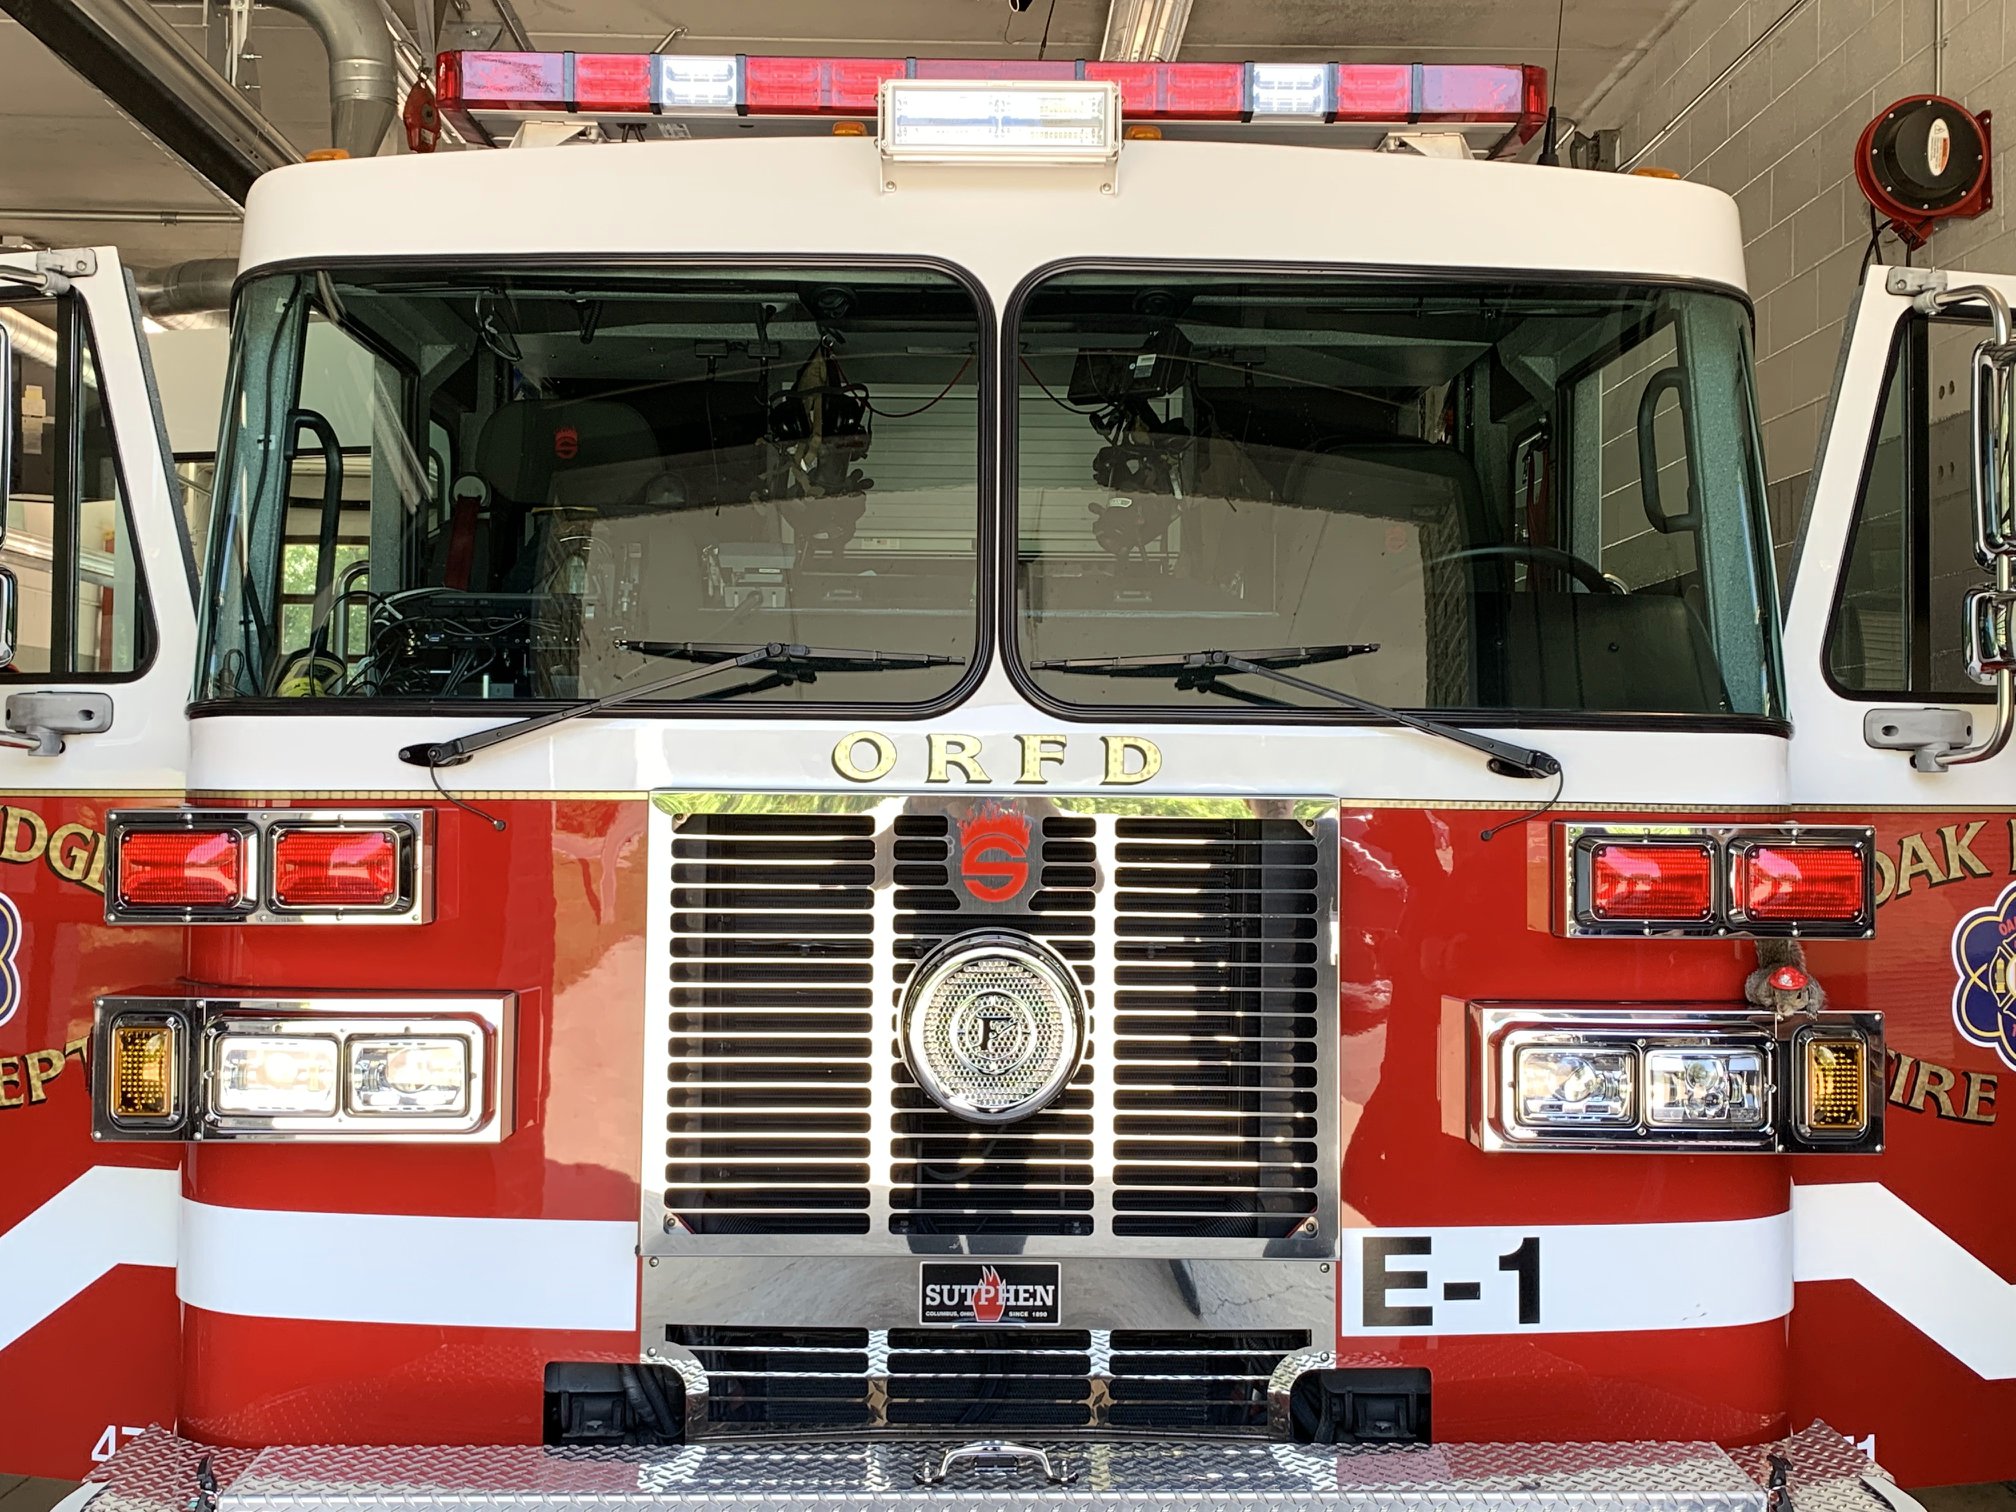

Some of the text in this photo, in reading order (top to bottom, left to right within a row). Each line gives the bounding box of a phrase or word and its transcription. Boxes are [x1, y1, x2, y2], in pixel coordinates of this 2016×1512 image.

[831, 730, 1163, 785] ORFD
[1886, 1047, 1998, 1126] IRE
[925, 1284, 1055, 1306] SUTPHEN
[1363, 1236, 1540, 1326] E-1
[1008, 1310, 1029, 1318] SINCE
